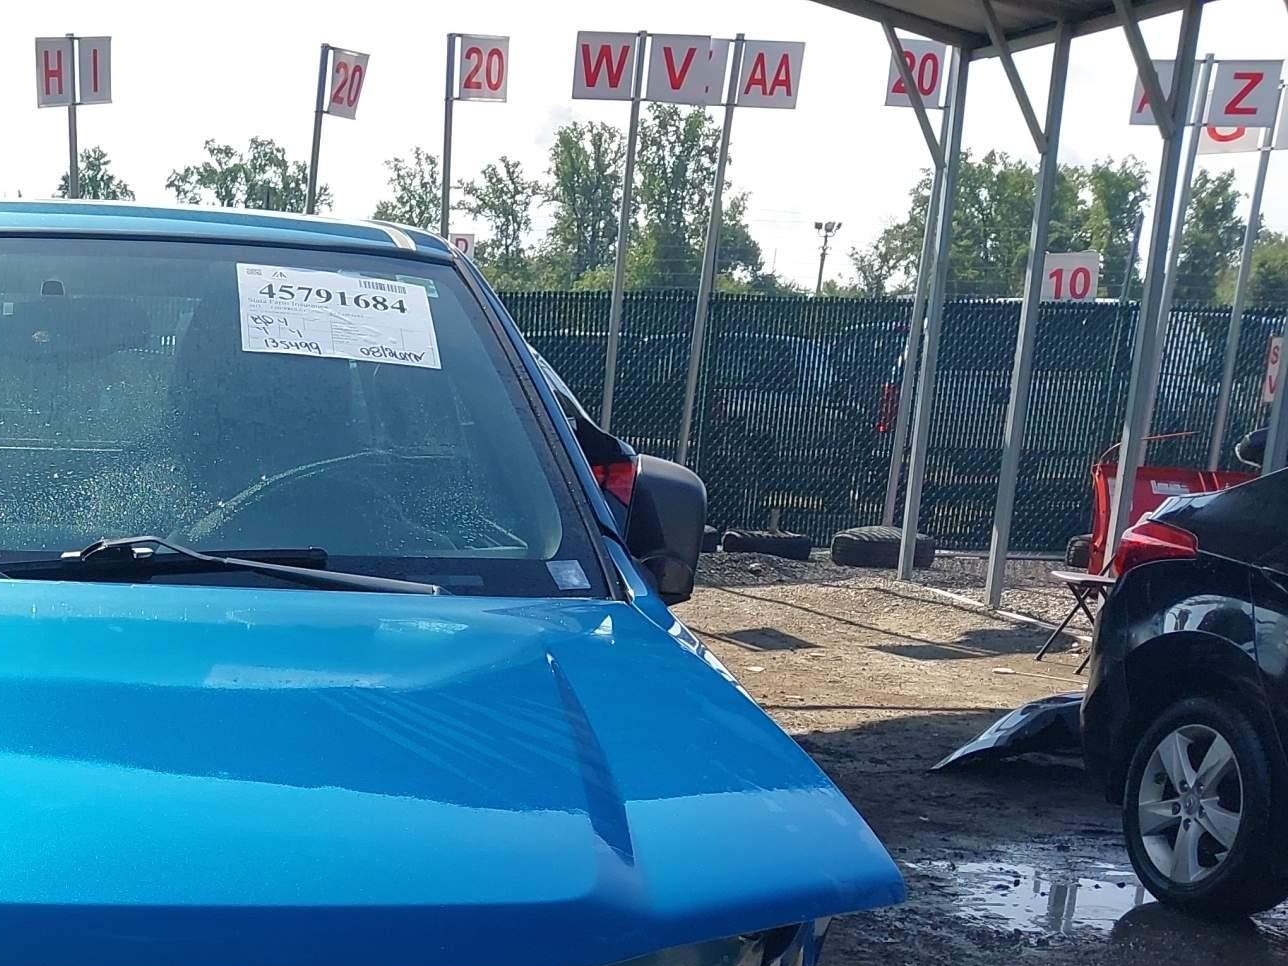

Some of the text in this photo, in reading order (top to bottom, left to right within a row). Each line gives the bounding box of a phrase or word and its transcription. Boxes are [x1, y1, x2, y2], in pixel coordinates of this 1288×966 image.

[43, 50, 63, 95] H
[92, 48, 98, 93] I
[332, 61, 363, 107] 20
[463, 46, 505, 92] 20
[581, 44, 630, 88] W
[663, 47, 697, 90] V
[743, 52, 792, 97] AA
[891, 50, 939, 96] 20
[1223, 72, 1264, 115] Z
[259, 283, 407, 313] 45791684
[1049, 267, 1091, 300] 10
[264, 337, 322, 355] 135499
